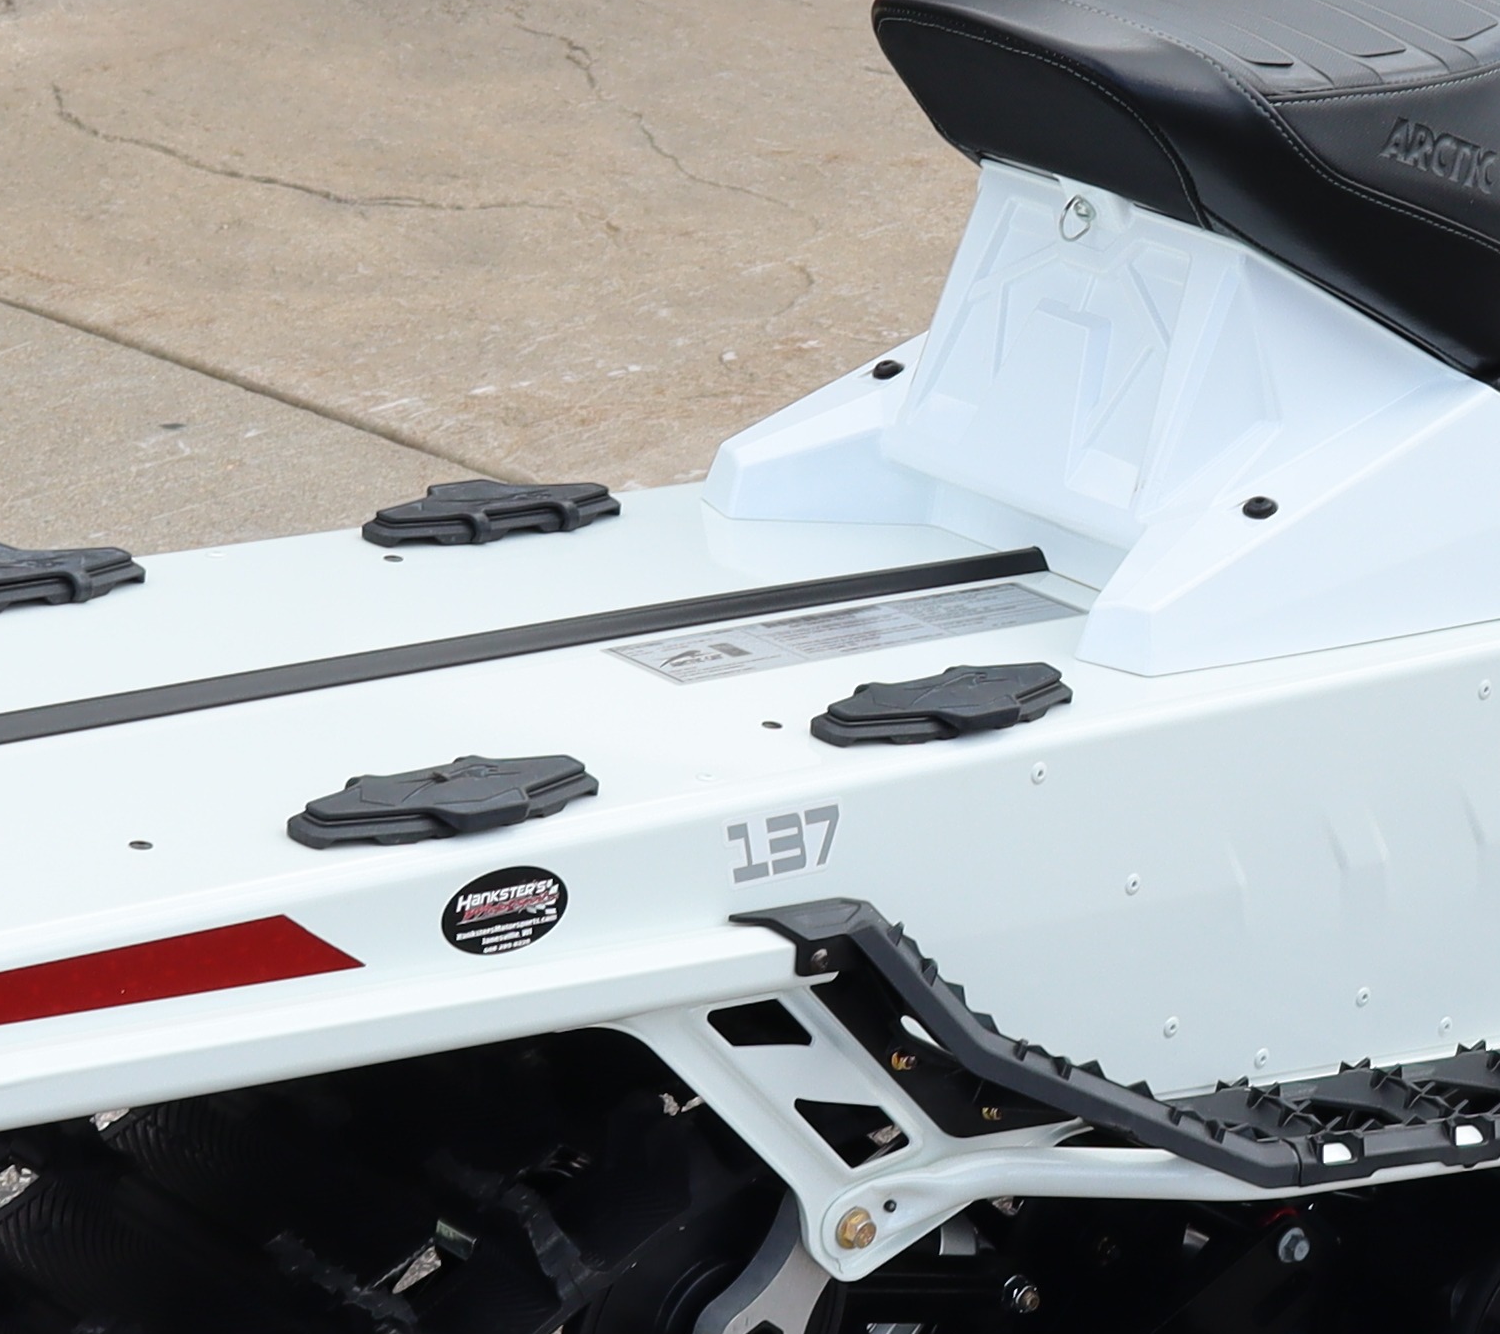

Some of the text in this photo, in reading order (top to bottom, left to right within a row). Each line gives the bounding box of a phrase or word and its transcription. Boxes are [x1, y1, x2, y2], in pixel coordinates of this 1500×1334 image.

[1377, 117, 1498, 195] ARCTIC
[726, 803, 840, 884] 137
[456, 880, 547, 914] HANKSTER'S
